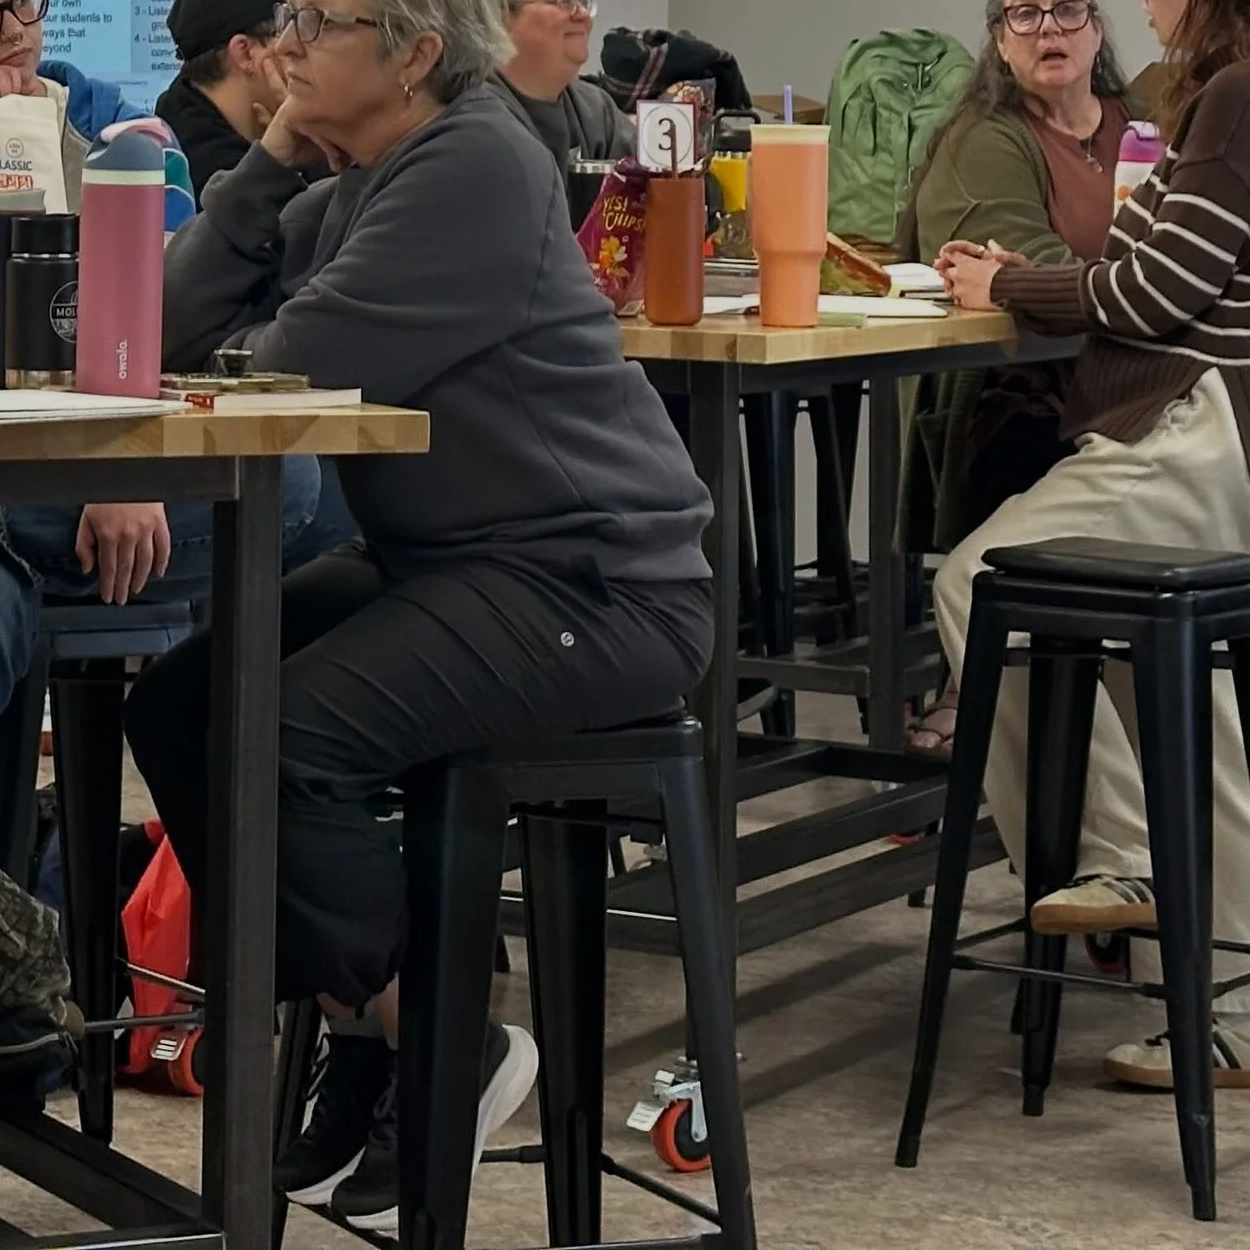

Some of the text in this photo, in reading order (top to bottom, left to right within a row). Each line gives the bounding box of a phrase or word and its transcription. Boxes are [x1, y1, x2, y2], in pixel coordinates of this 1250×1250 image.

[61, 0, 82, 8] own
[61, 12, 100, 23] students
[103, 13, 112, 23] to
[134, 34, 140, 43] 4
[658, 117, 674, 150] 3
[115, 338, 128, 380] owala
